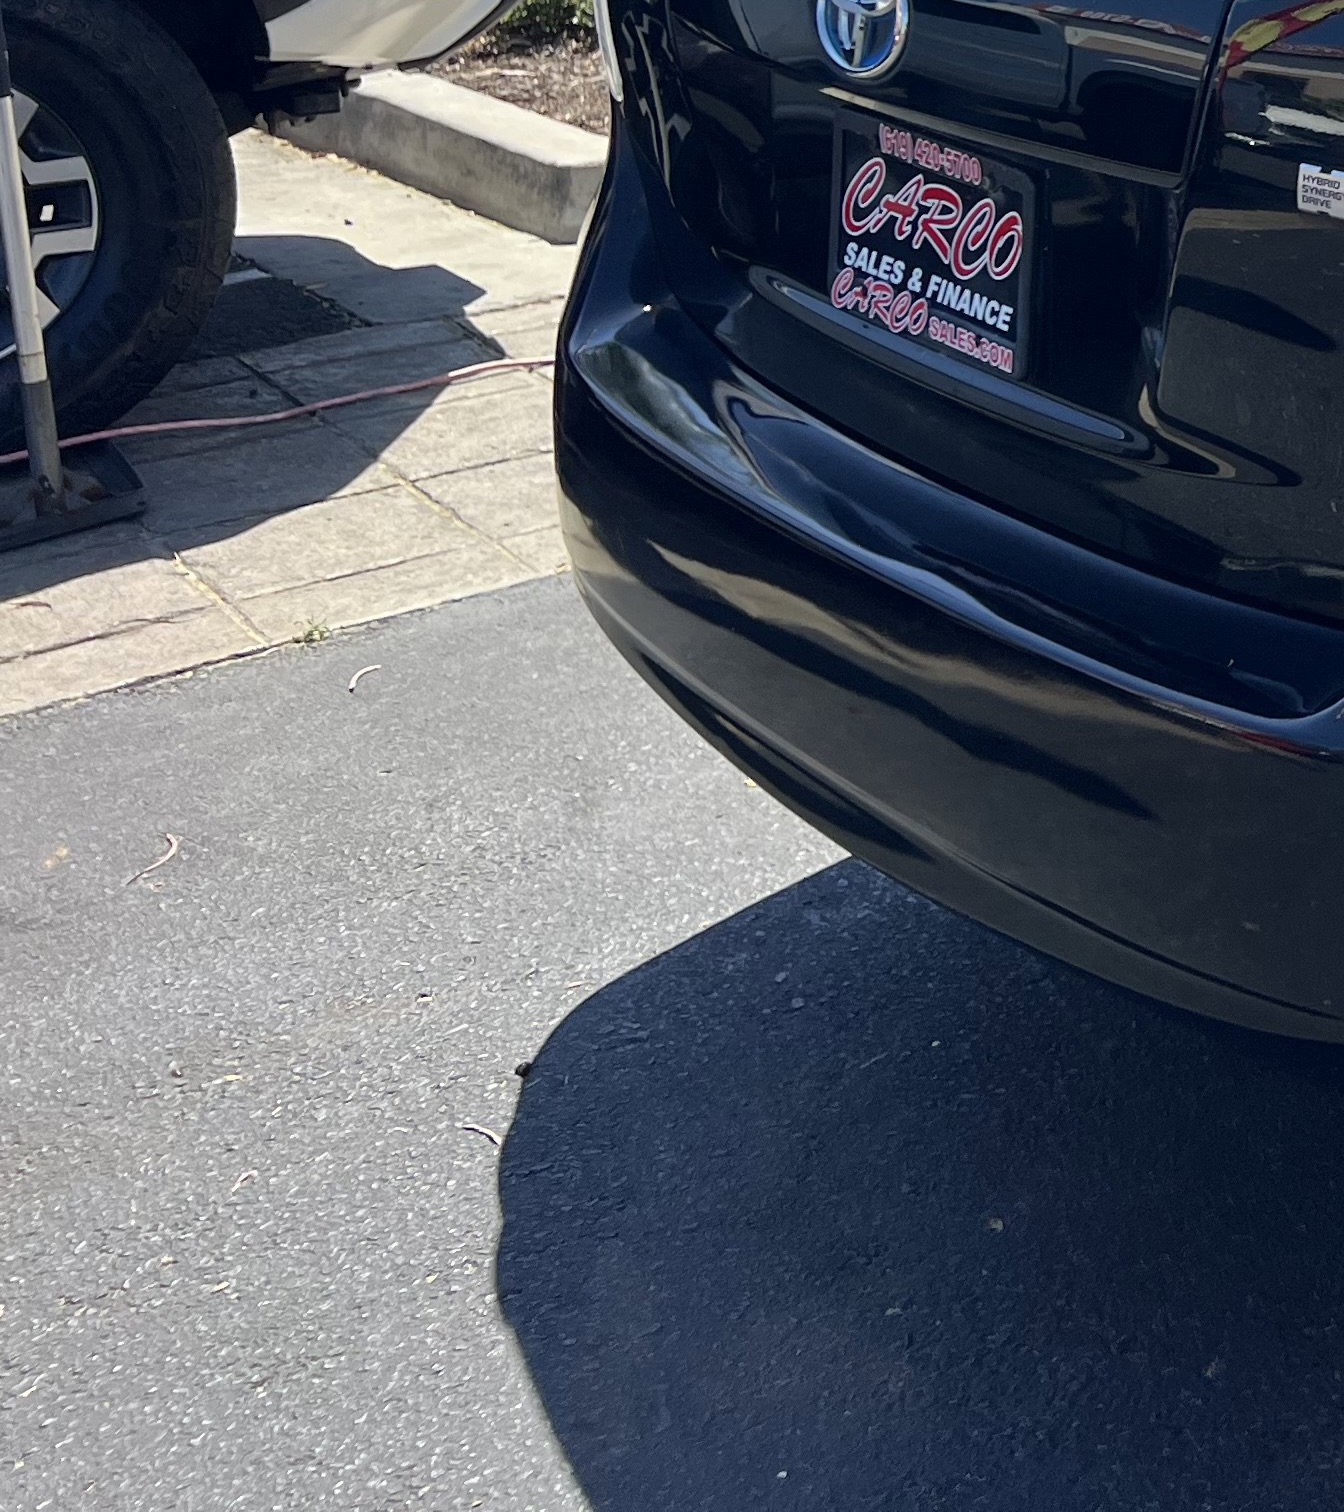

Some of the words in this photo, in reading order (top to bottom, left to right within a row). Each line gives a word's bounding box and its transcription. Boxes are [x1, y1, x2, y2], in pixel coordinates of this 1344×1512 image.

[878, 122, 914, 164] (619)
[914, 138, 983, 186] 420-5700
[1302, 173, 1341, 190] HYBRID
[842, 157, 1023, 280] CARCO
[1301, 194, 1333, 209] DRIVE
[831, 267, 929, 335] CARCO
[928, 316, 1015, 374] SALES.COM
[843, 242, 906, 285] SALES
[907, 267, 923, 293] &
[925, 274, 1015, 332] FINANCE
